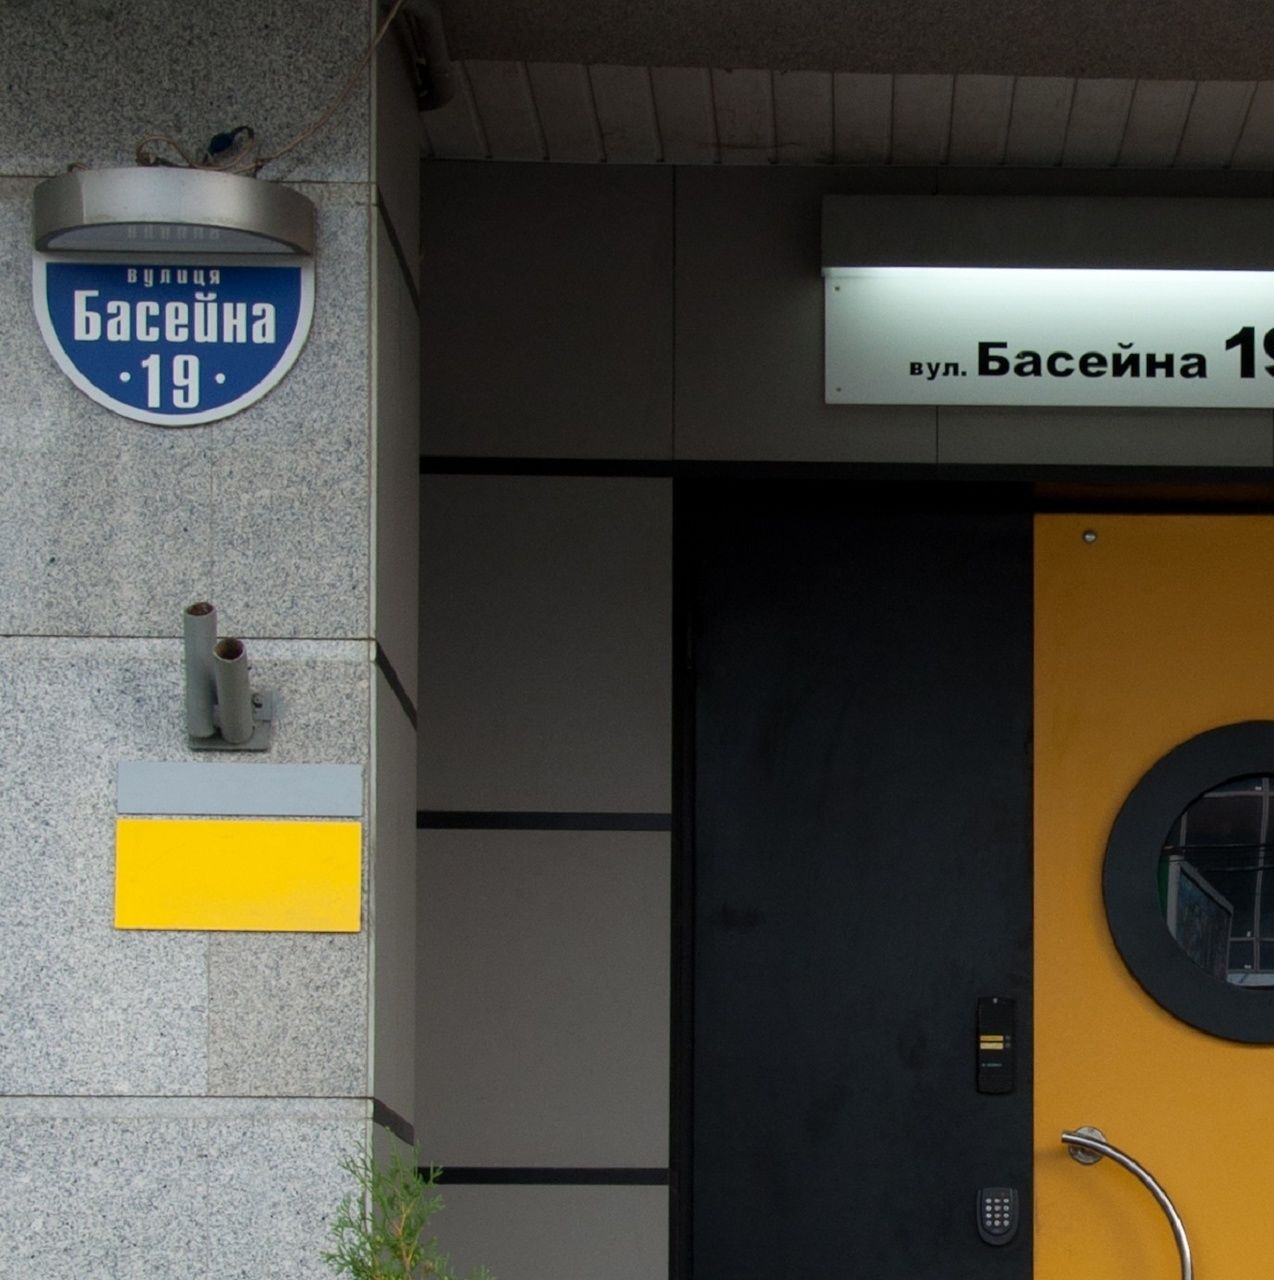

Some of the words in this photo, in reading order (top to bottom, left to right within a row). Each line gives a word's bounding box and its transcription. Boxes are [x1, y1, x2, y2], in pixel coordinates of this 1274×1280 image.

[127, 268, 221, 287] вулиця
[73, 290, 276, 344] Басейна
[141, 353, 200, 409] 19
[909, 360, 968, 380] вул.
[977, 341, 1208, 379] Басейна
